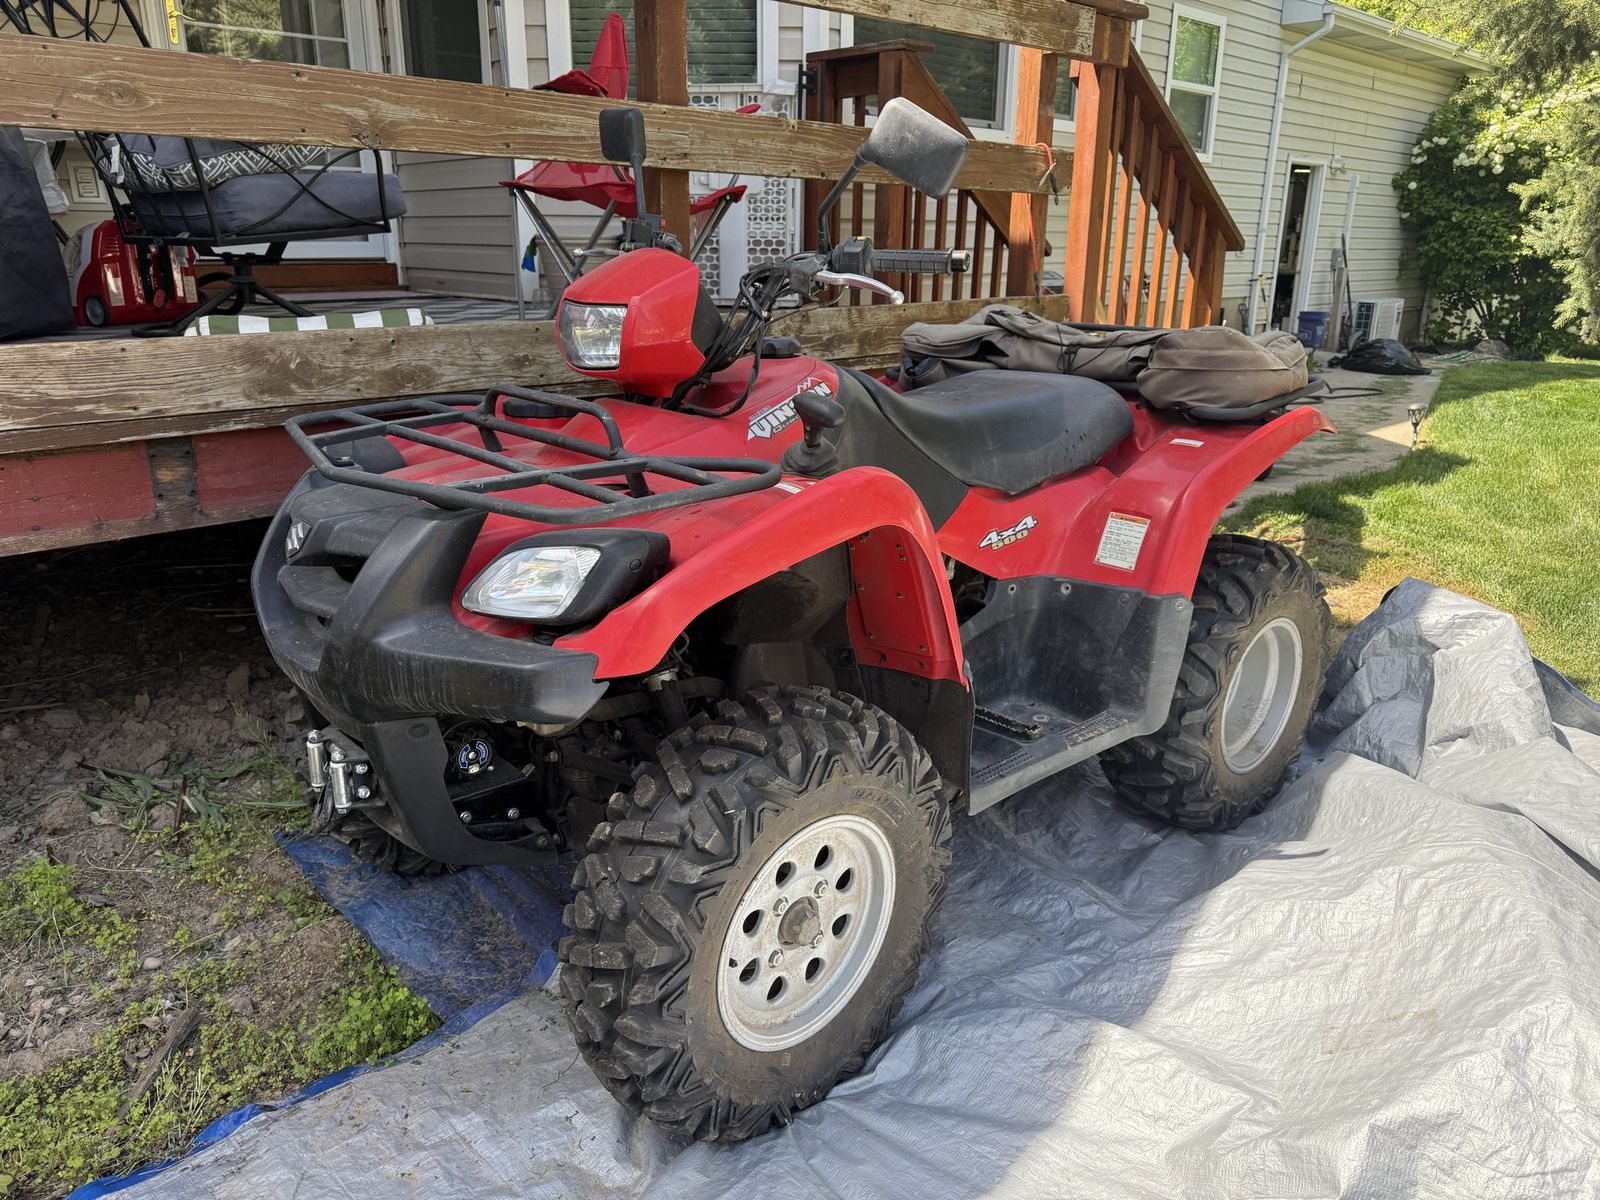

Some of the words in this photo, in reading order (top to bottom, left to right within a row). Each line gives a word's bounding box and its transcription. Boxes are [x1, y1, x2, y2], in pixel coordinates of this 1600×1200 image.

[750, 381, 833, 438] VINN
[979, 515, 1038, 548] 4x4
[992, 529, 1029, 551] 500
